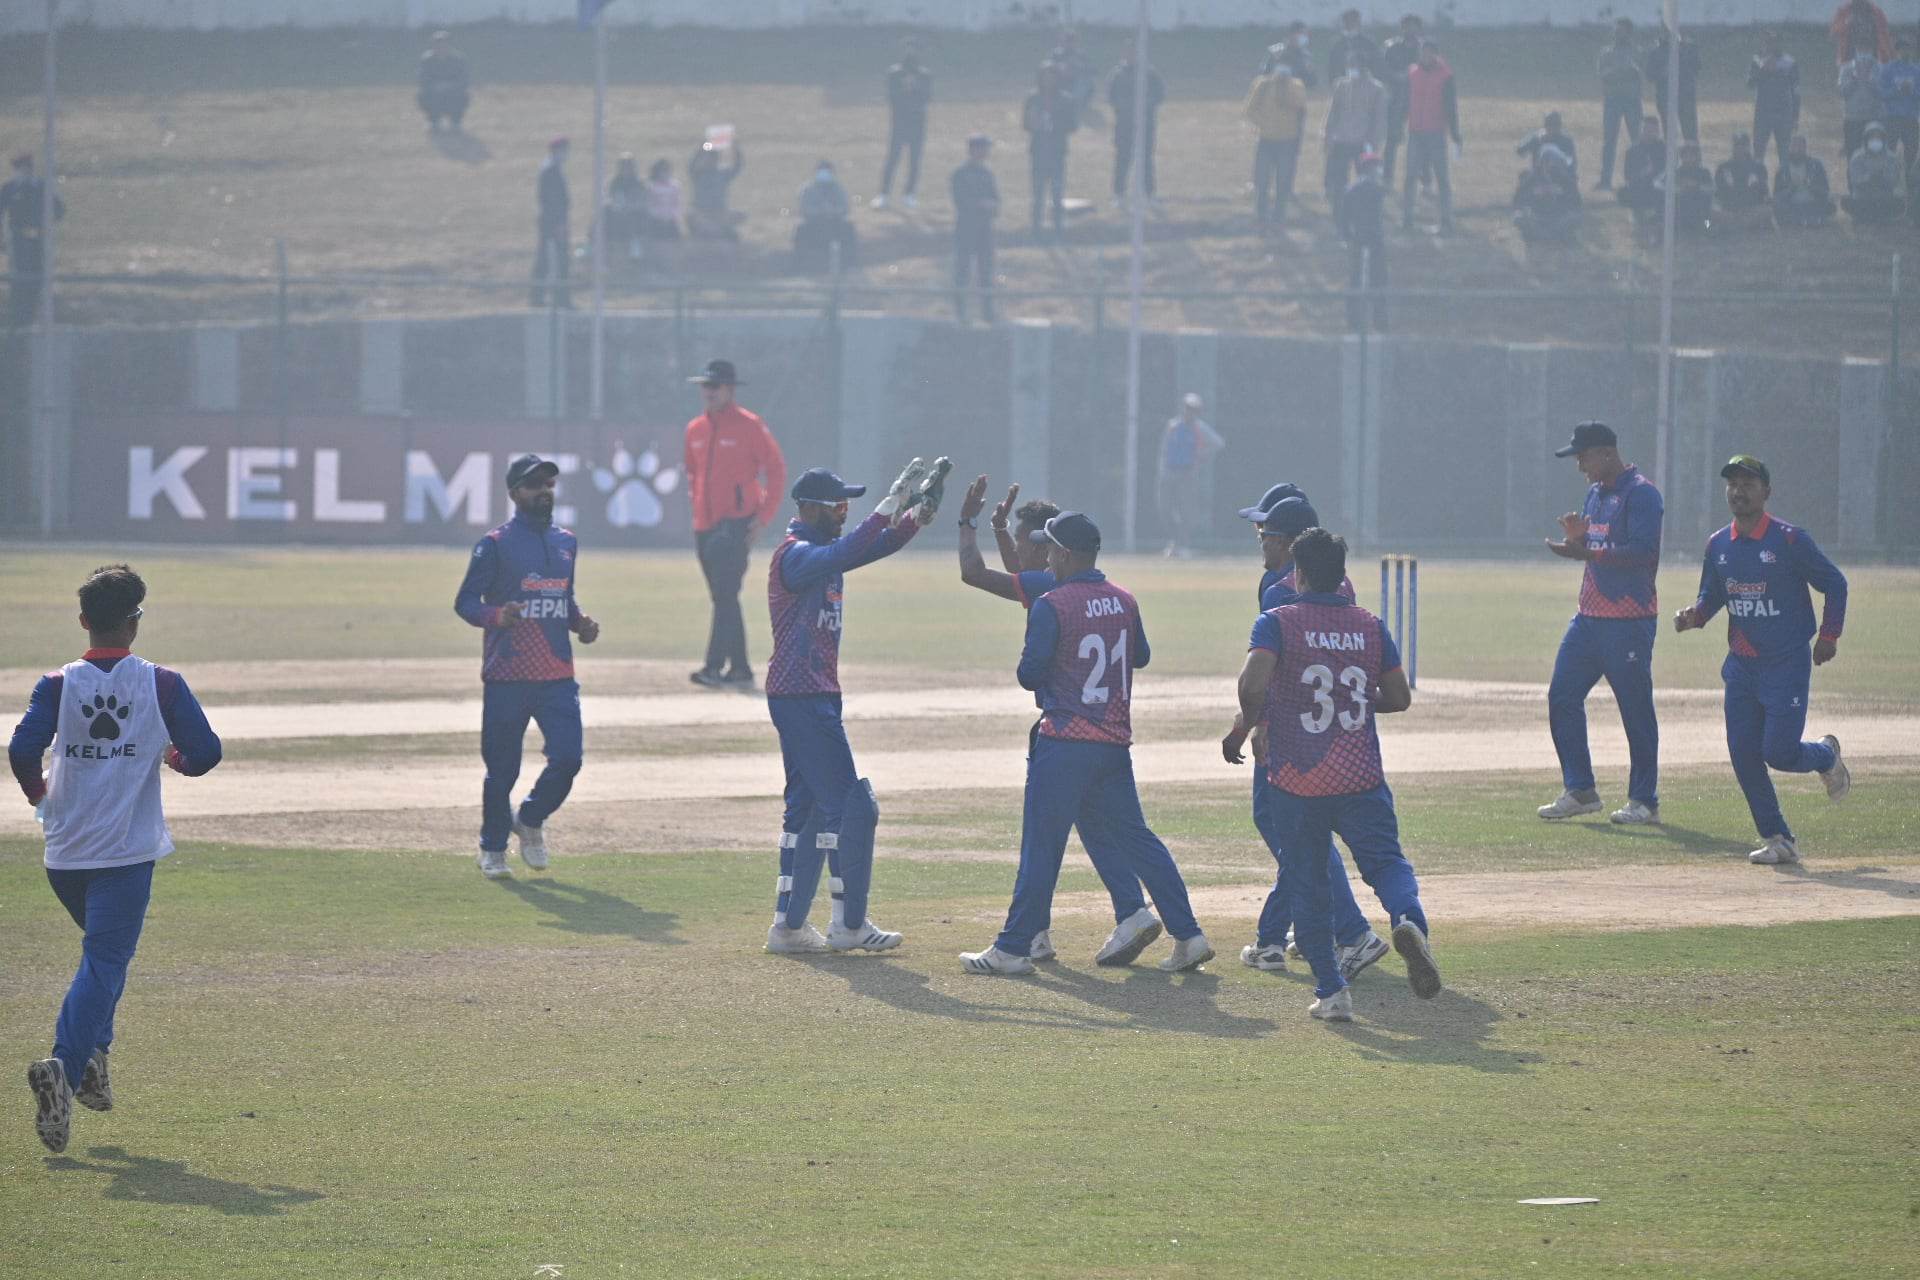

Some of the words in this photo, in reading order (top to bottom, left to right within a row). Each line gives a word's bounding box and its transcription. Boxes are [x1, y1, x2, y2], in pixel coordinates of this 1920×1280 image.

[1086, 597, 1124, 618] JORA
[1305, 631, 1365, 650] KARAN
[1078, 629, 1128, 705] 21
[1301, 664, 1368, 734] 33
[65, 743, 136, 760] KELME
